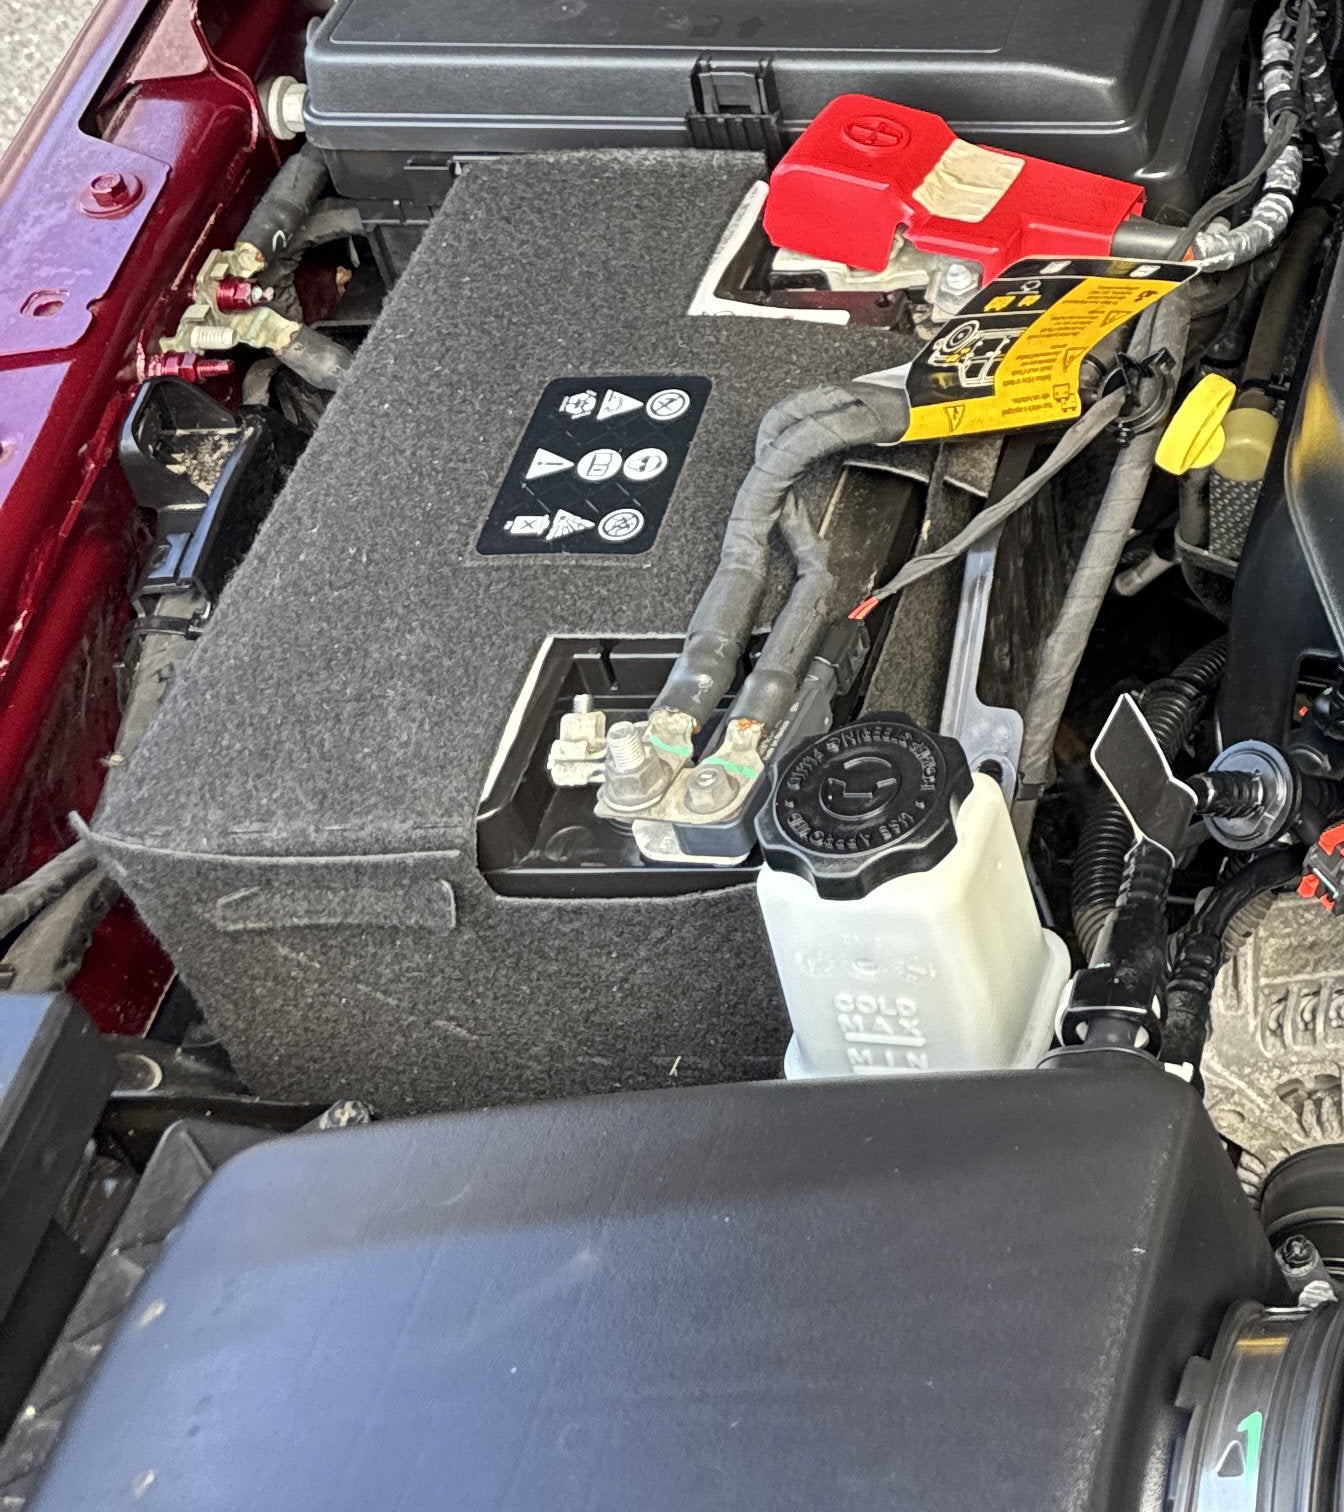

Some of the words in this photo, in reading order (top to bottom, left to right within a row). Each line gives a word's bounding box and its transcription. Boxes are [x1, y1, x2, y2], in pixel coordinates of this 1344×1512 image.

[834, 992, 918, 1016] COLD
[838, 1014, 923, 1037] MAX
[847, 1047, 928, 1069] MIN
